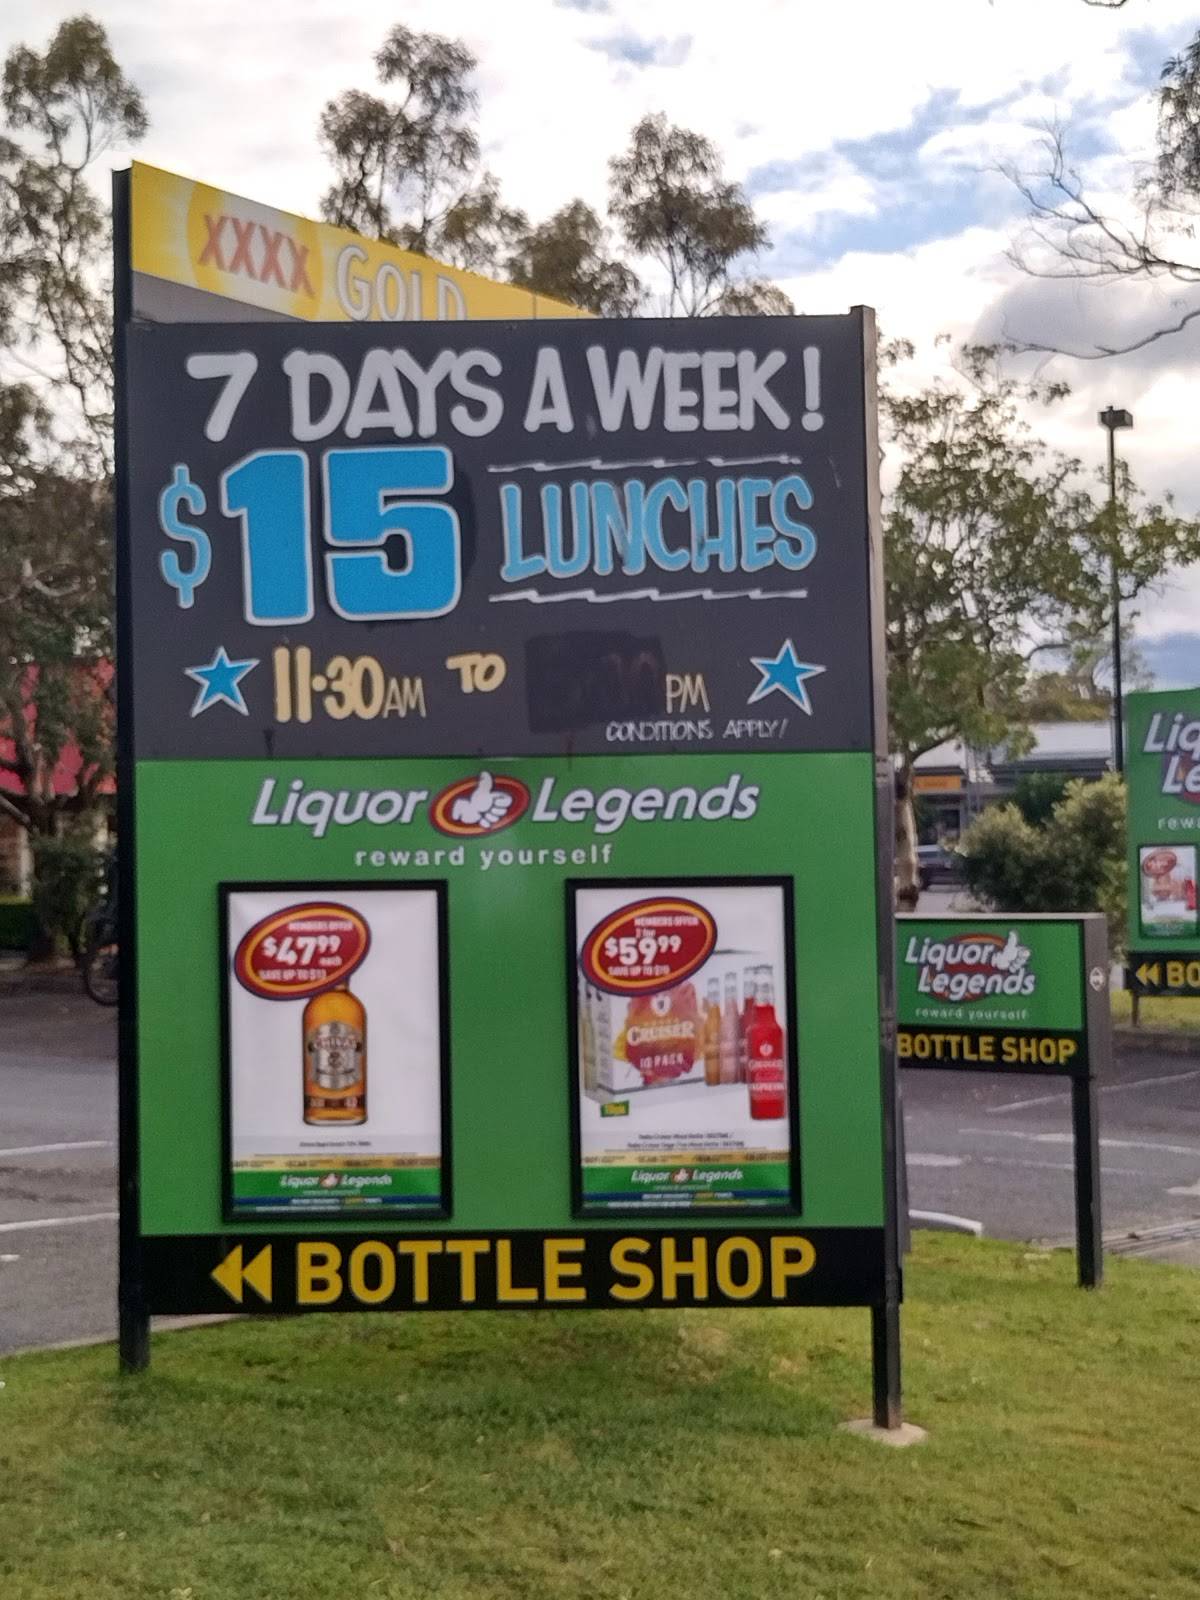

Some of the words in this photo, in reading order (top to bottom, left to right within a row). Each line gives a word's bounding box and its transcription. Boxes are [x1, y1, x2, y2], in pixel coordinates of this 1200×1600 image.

[197, 214, 316, 299] XXXX
[336, 243, 467, 321] GOLD
[186, 351, 258, 442] 7
[282, 349, 503, 441] DAYS
[523, 347, 573, 433] A
[586, 346, 825, 434] WEEK!
[159, 445, 463, 626] $15
[500, 475, 817, 582] LUNCHES
[445, 653, 507, 694] TO
[665, 672, 711, 714] PM
[605, 720, 714, 741] CONDITIONS
[250, 776, 429, 839] Liquor
[530, 774, 761, 834] Legends
[355, 846, 466, 868] reward
[479, 843, 613, 870] yourself
[905, 937, 995, 970] Liquor
[918, 965, 1035, 1001] Legends
[915, 1006, 963, 1018] reward
[968, 1008, 1028, 1021] yourself
[897, 1032, 996, 1062] BOTTLE
[1001, 1035, 1077, 1065] SHOP
[297, 1238, 587, 1304] BOTTLE
[608, 1236, 817, 1301] SHOP
